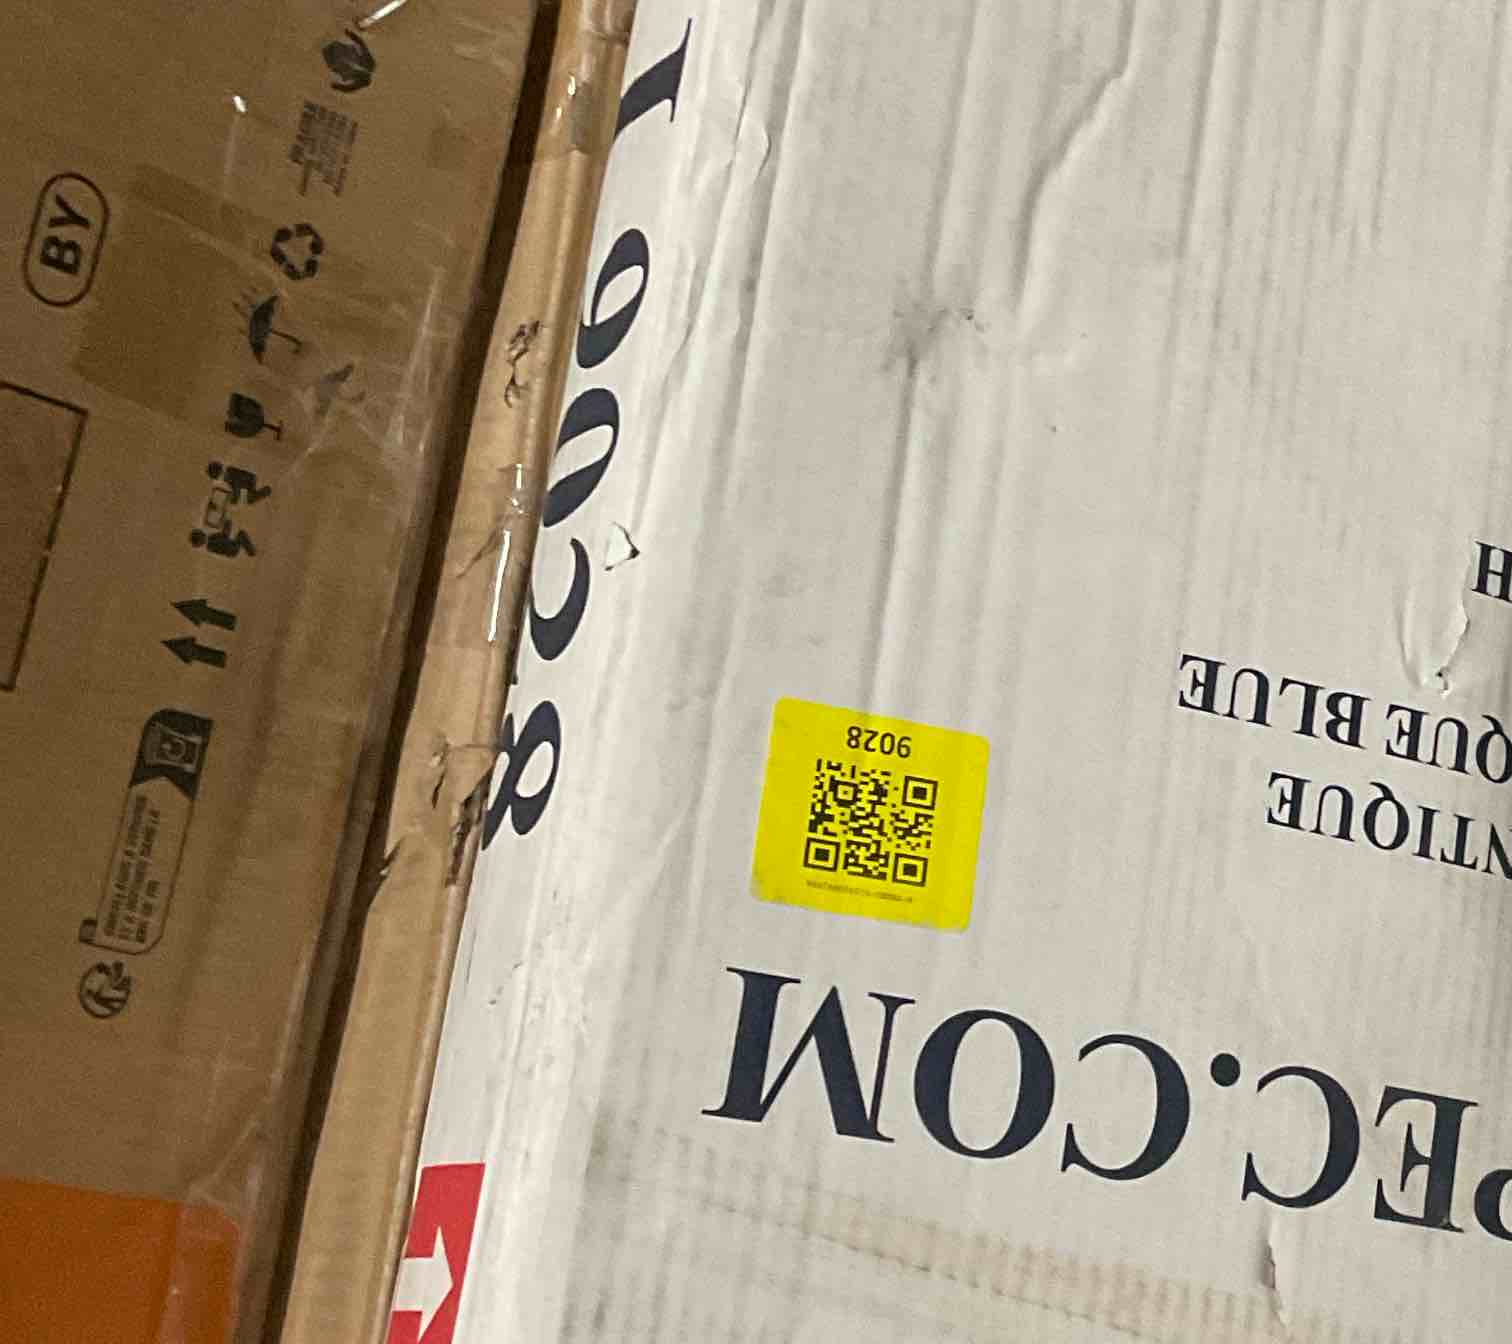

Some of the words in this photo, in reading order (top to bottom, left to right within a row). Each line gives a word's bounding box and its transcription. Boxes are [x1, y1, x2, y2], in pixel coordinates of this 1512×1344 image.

[39, 192, 91, 277] BY
[845, 723, 913, 759] 9028
[1177, 653, 1369, 751] BLUE
